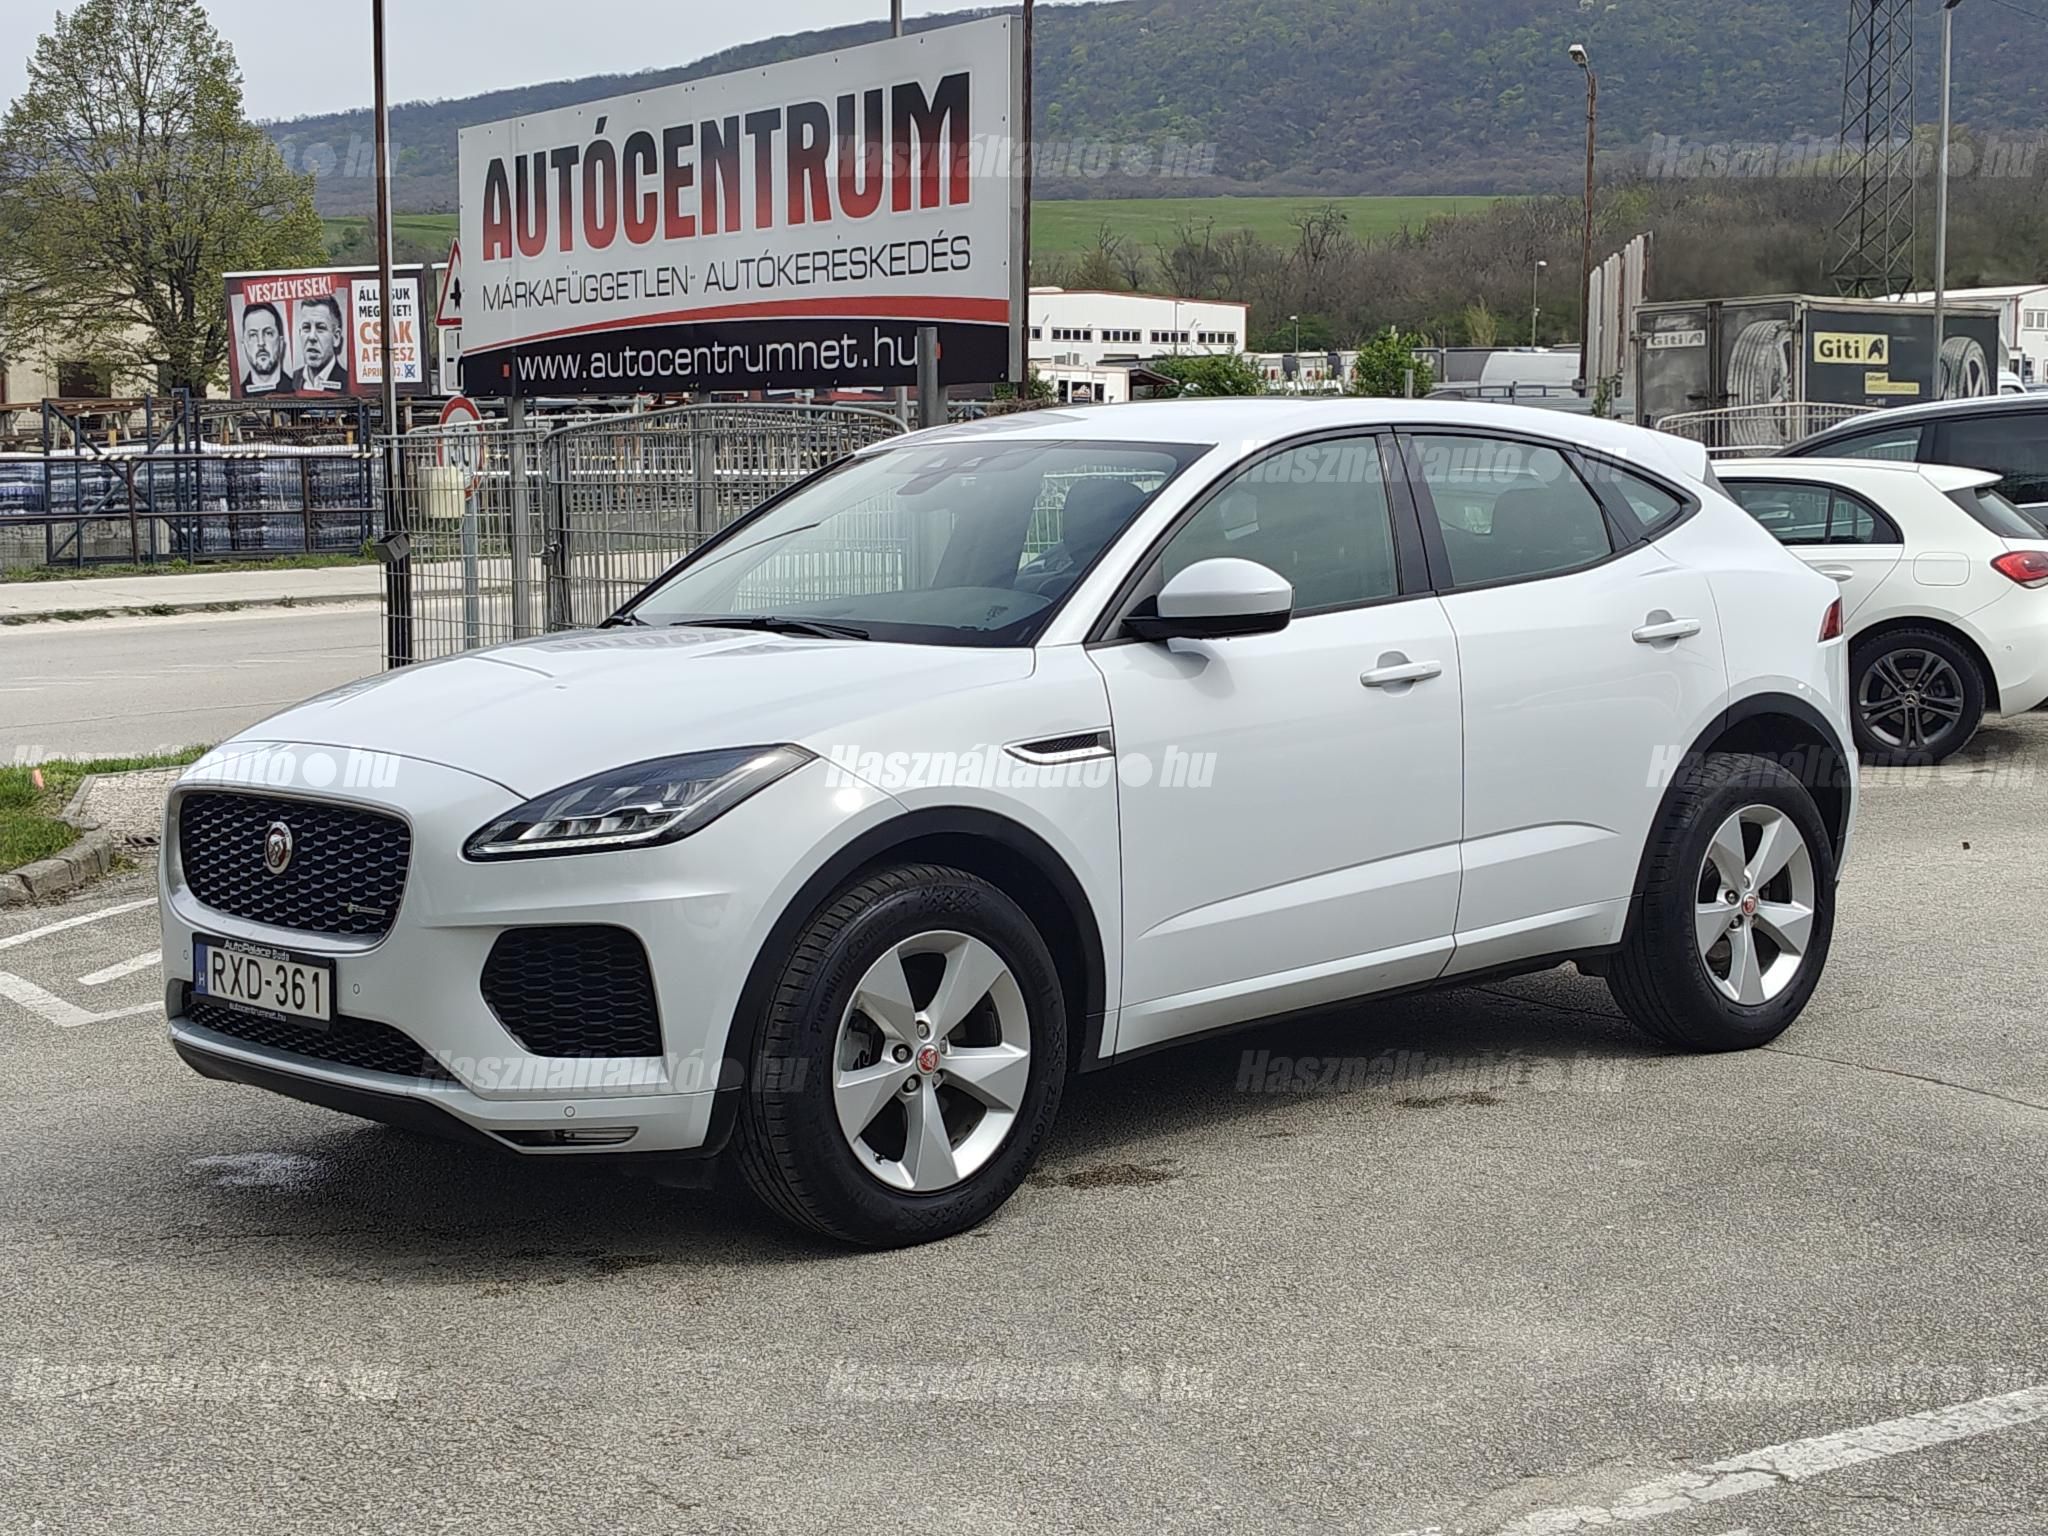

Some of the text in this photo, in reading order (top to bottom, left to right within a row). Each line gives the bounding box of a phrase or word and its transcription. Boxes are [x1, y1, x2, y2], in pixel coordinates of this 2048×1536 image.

[482, 72, 971, 262] AUTÓCENTRUM
[704, 230, 971, 294] AUTÓKERESKEDÉS
[247, 275, 333, 303] VESZÉLYESEK!
[359, 285, 411, 302] ÁLLSUK
[361, 346, 415, 362] A FESZ
[517, 326, 919, 381] www.autocentrumnet.hu
[1818, 337, 1861, 360] Giti
[223, 939, 272, 958] AutoPalace
[211, 951, 321, 1015] RXD-361
